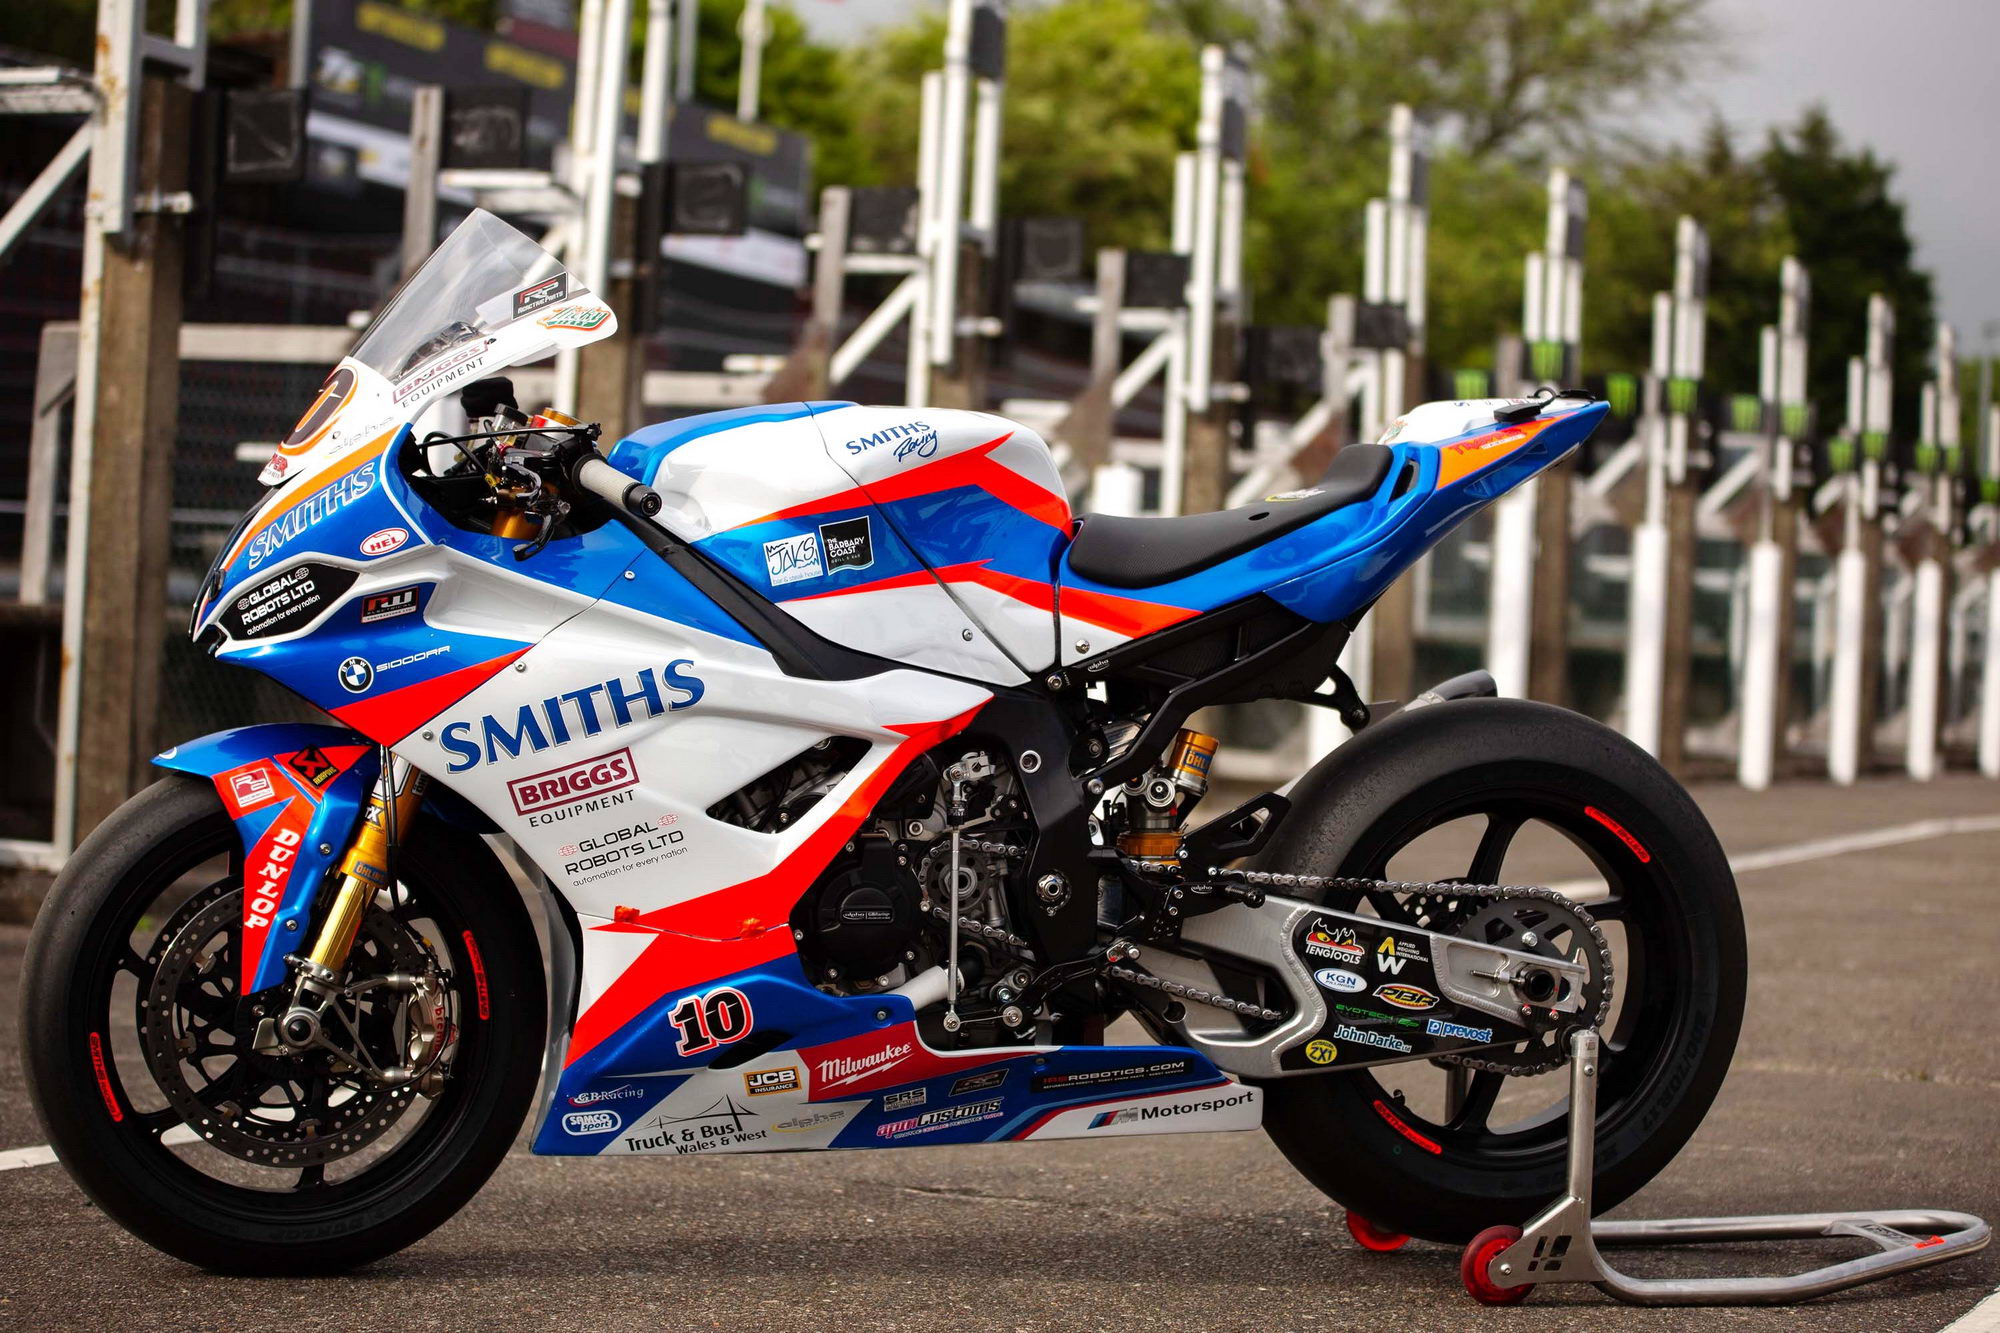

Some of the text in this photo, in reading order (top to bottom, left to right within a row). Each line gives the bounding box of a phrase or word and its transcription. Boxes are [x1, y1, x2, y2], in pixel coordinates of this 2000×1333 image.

[399, 346, 481, 396] BRIGGS
[402, 357, 485, 408] EQUIPMENT
[845, 421, 931, 455] SMITHS
[893, 429, 938, 463] Racing
[248, 461, 376, 570] SMITHS
[369, 536, 401, 552] HEL
[828, 536, 865, 551] BARBARY
[829, 545, 857, 558] COAST
[241, 580, 316, 625] ROBOTS LTD
[248, 573, 298, 604] GLOBAL
[247, 594, 321, 636] automation for every nation
[439, 658, 706, 776] SMITHS
[517, 757, 628, 807] BRIGGS
[528, 789, 635, 828] EQUIPMENT
[578, 820, 659, 853] GLOBAL
[564, 829, 685, 876] ROBOTS LTD
[572, 846, 688, 887] automation for every nation
[244, 828, 300, 929] DUNLOP
[1306, 942, 1361, 965] TENGTOOLS
[1396, 951, 1429, 963] INTERNATIONAL
[1326, 972, 1357, 985] KGN
[1373, 986, 1440, 1007] PBR
[668, 986, 754, 1058] 10
[1335, 1003, 1394, 1021] EVOTECH
[1334, 1025, 1412, 1053] John Darke Ltd
[1442, 1022, 1492, 1043] prevost
[815, 1043, 912, 1083] Milwaukee
[1311, 1046, 1334, 1062] ZX1
[750, 1067, 796, 1086] JCB
[755, 1081, 796, 1094] INSURANCE
[885, 1090, 925, 1103] SRS
[1141, 1090, 1254, 1121] Motorsport
[570, 1113, 610, 1126] SAMCO
[582, 1119, 613, 1132] sport
[625, 1122, 735, 1152] Truck & Bus
[675, 1129, 768, 1155] Wales & West
